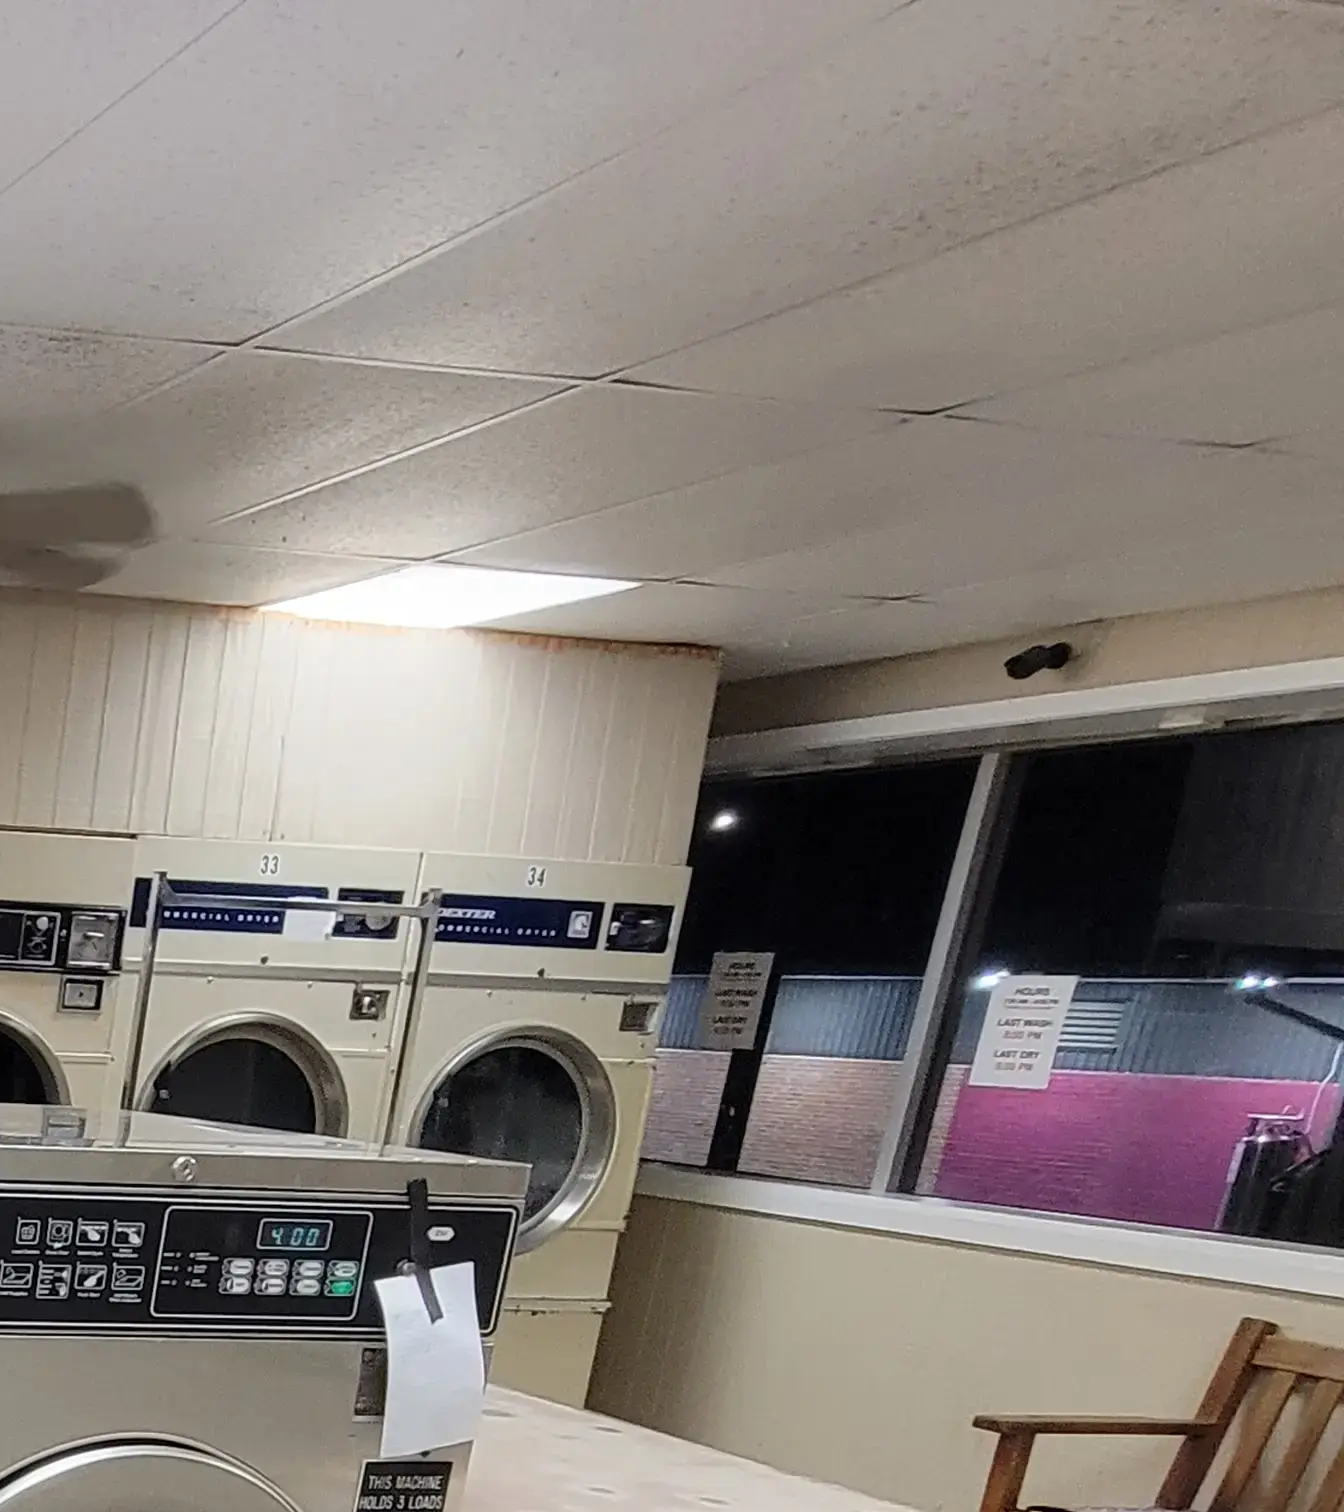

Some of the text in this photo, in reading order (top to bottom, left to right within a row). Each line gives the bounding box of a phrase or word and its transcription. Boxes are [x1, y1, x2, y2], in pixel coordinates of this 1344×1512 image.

[260, 855, 280, 874] 33
[527, 867, 547, 887] 34
[437, 907, 497, 920] DEXTER
[996, 1018, 1021, 1027] LAST
[994, 1049, 1019, 1058] LAST
[368, 1475, 444, 1490] THIS MACHINE
[358, 1495, 443, 1510] HOLDS 3 LOADS
